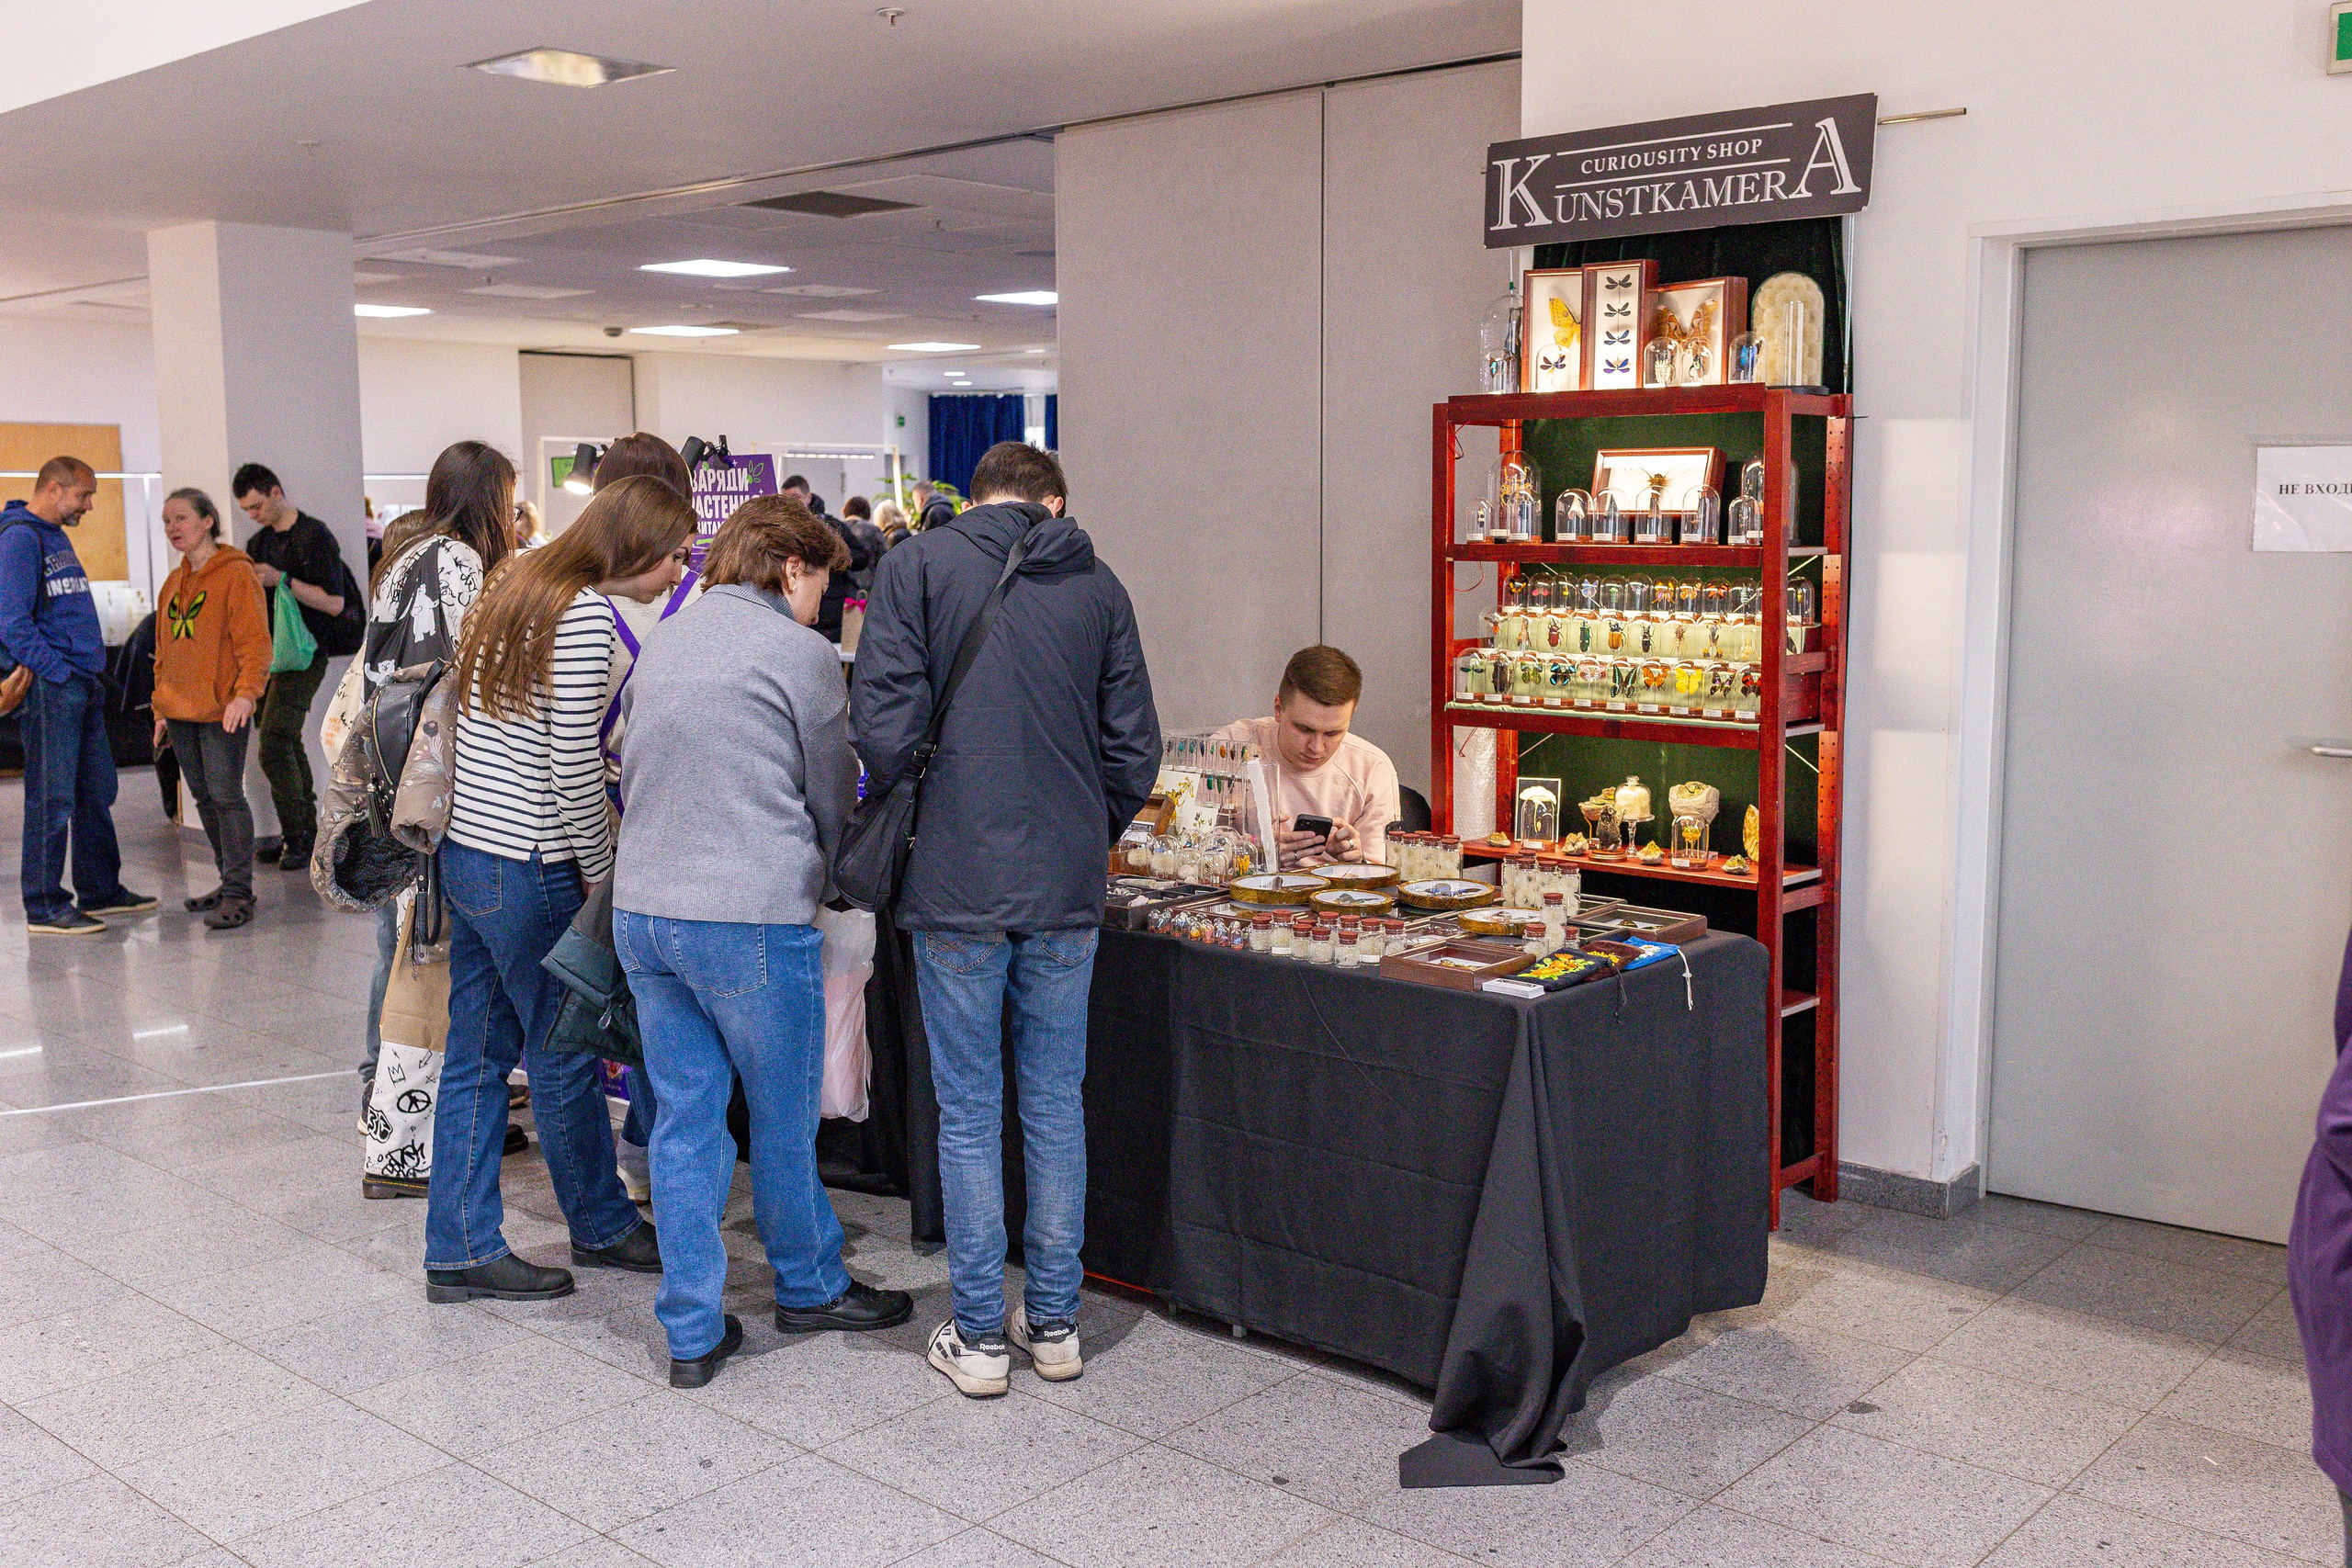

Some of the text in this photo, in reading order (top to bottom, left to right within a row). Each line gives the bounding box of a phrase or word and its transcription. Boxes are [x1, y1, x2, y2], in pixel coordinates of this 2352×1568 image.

[1580, 139, 1763, 175] CURIOUSITY SHOP
[1489, 117, 1862, 231] KUNSTKAMERA
[2278, 482, 2352, 496] НЕ ВХОД
[1044, 1327, 1070, 1338] Reebok
[979, 1343, 1006, 1351] Reebok
